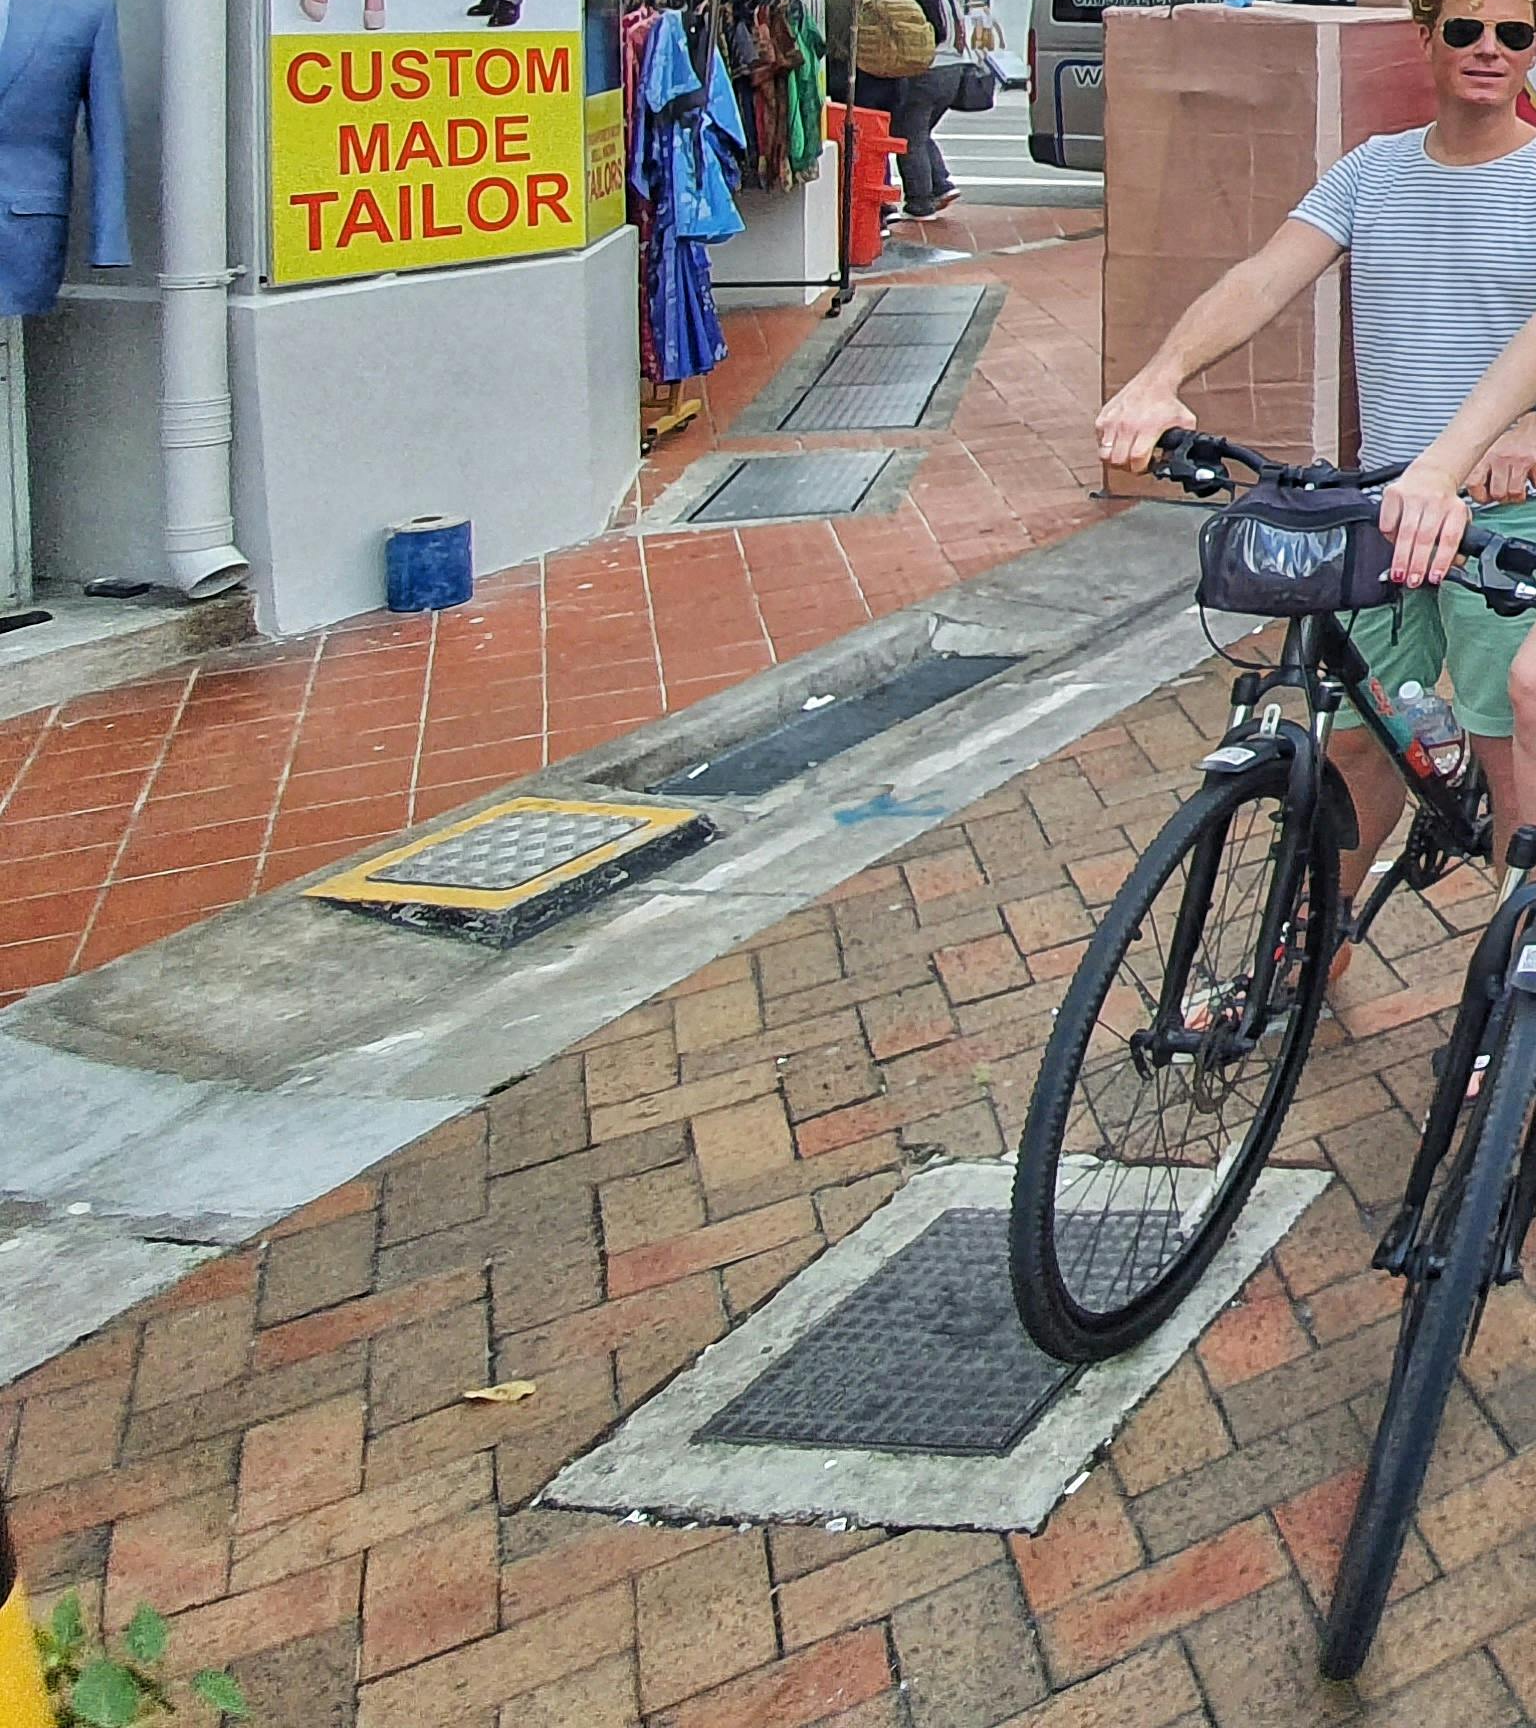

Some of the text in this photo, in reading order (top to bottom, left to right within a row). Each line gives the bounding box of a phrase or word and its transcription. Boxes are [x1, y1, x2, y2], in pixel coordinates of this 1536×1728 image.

[286, 47, 570, 104] CUSTOM
[338, 115, 531, 176] MADE
[289, 172, 573, 252] TAILOR
